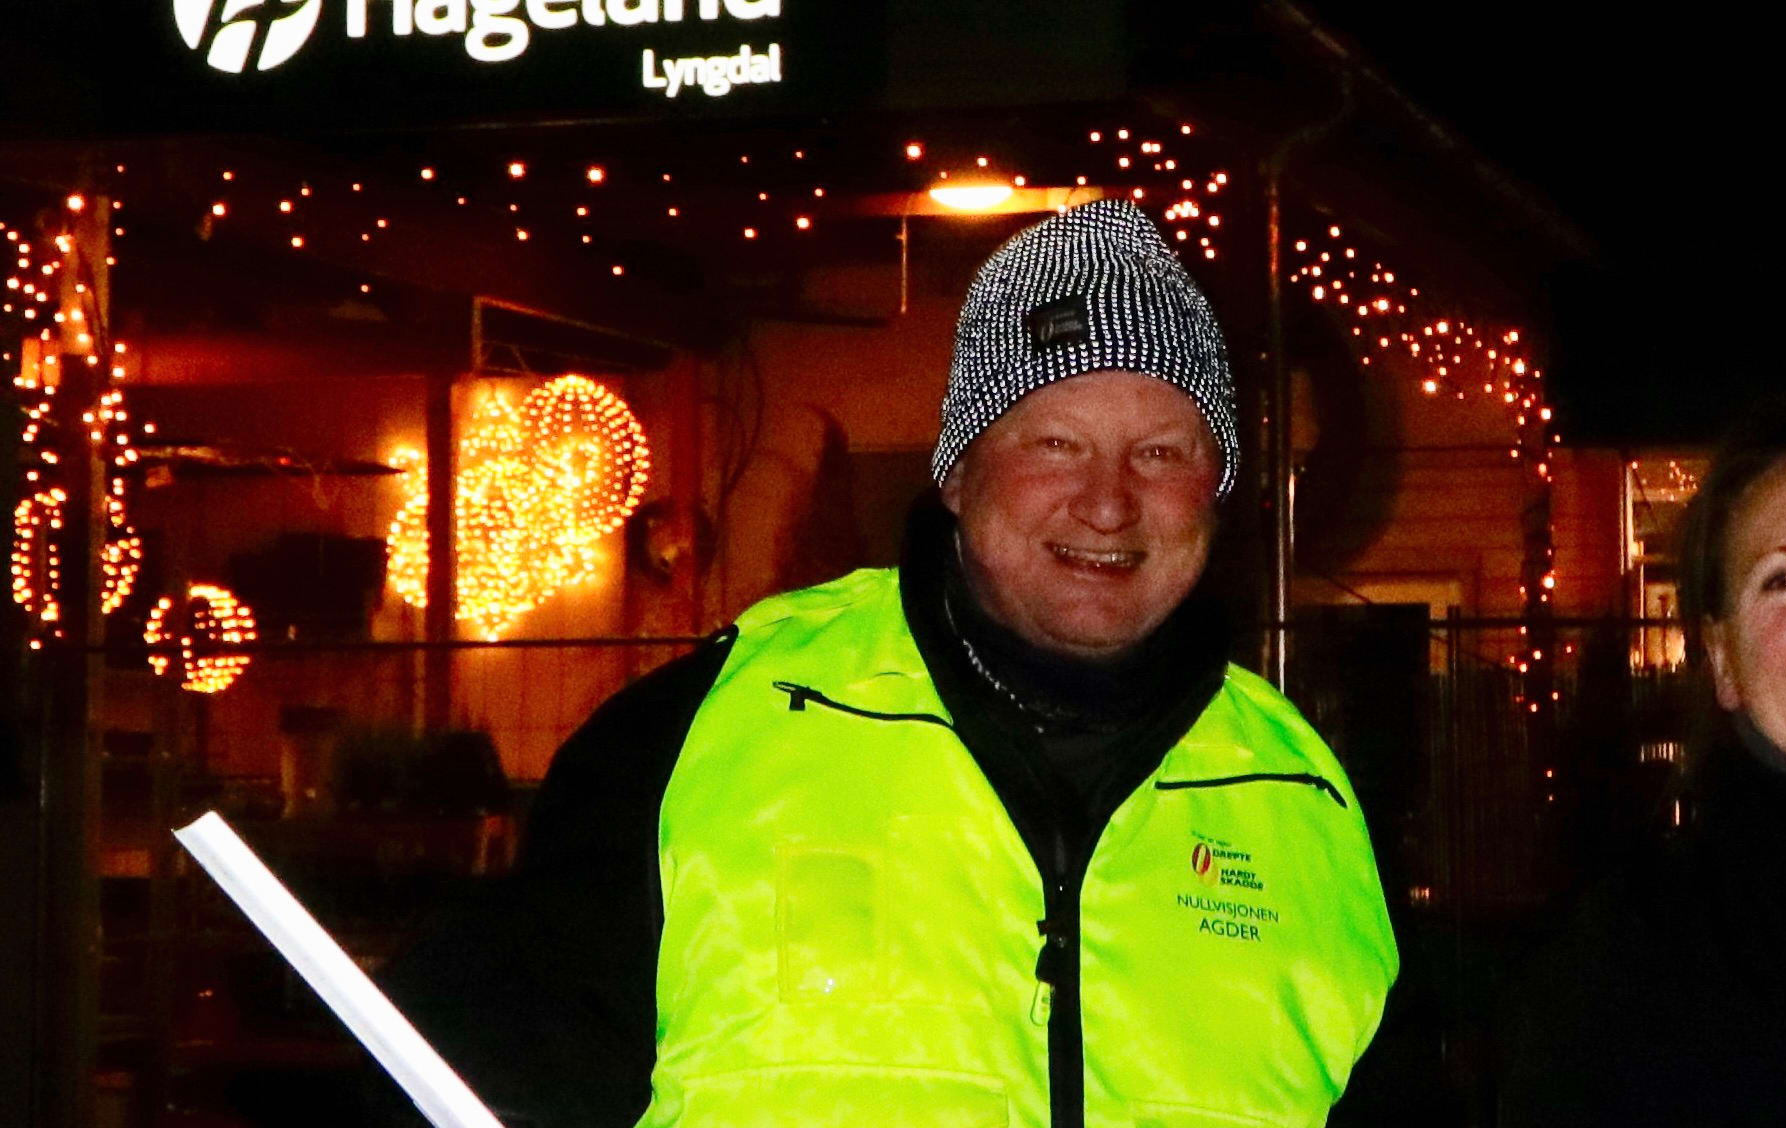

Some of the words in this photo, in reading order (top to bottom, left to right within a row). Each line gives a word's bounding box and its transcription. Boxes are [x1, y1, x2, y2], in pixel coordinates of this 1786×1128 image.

[346, 0, 782, 62] agea
[643, 43, 782, 97] Lyngdal
[1177, 894, 1279, 923] NULLVISJONEN
[1199, 918, 1262, 941] AGDER
